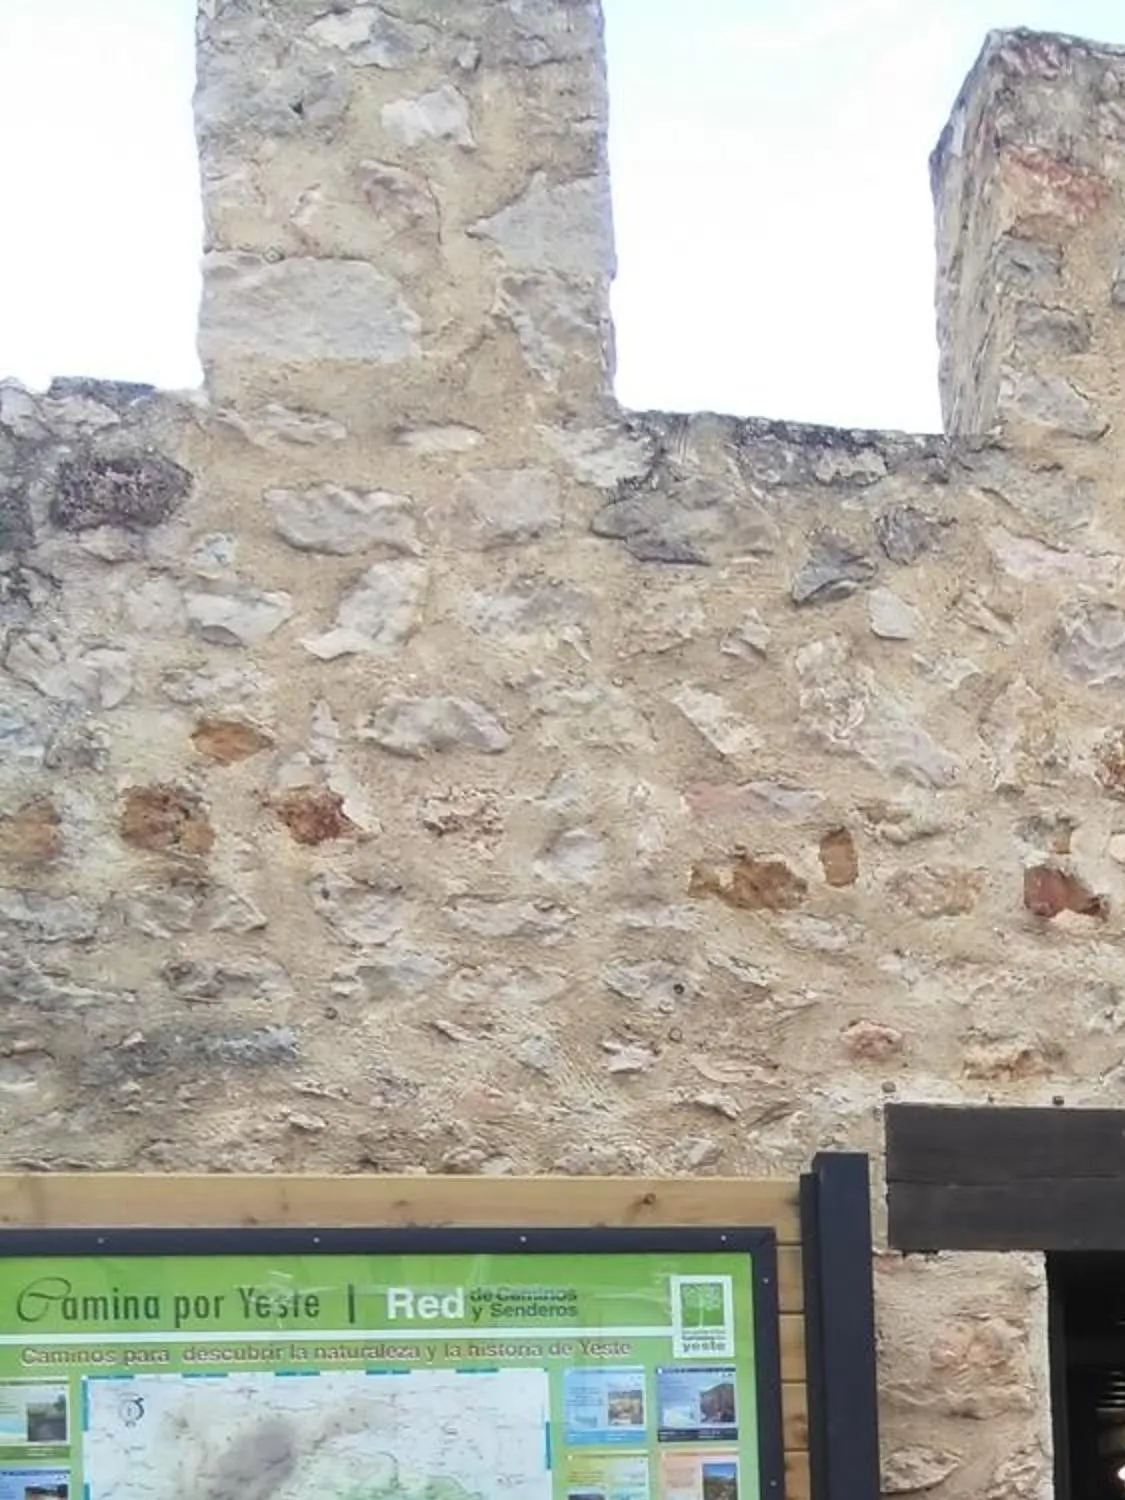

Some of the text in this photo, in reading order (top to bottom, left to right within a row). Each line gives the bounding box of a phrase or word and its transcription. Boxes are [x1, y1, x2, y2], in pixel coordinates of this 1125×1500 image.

[16, 1277, 320, 1328] Camina por Yeste
[386, 1286, 465, 1320] Red
[470, 1285, 578, 1302] de Caminos
[471, 1302, 579, 1323] y Senderos
[21, 1336, 632, 1369] Caminos para descubrir la naturaleza y la historia de Yeste
